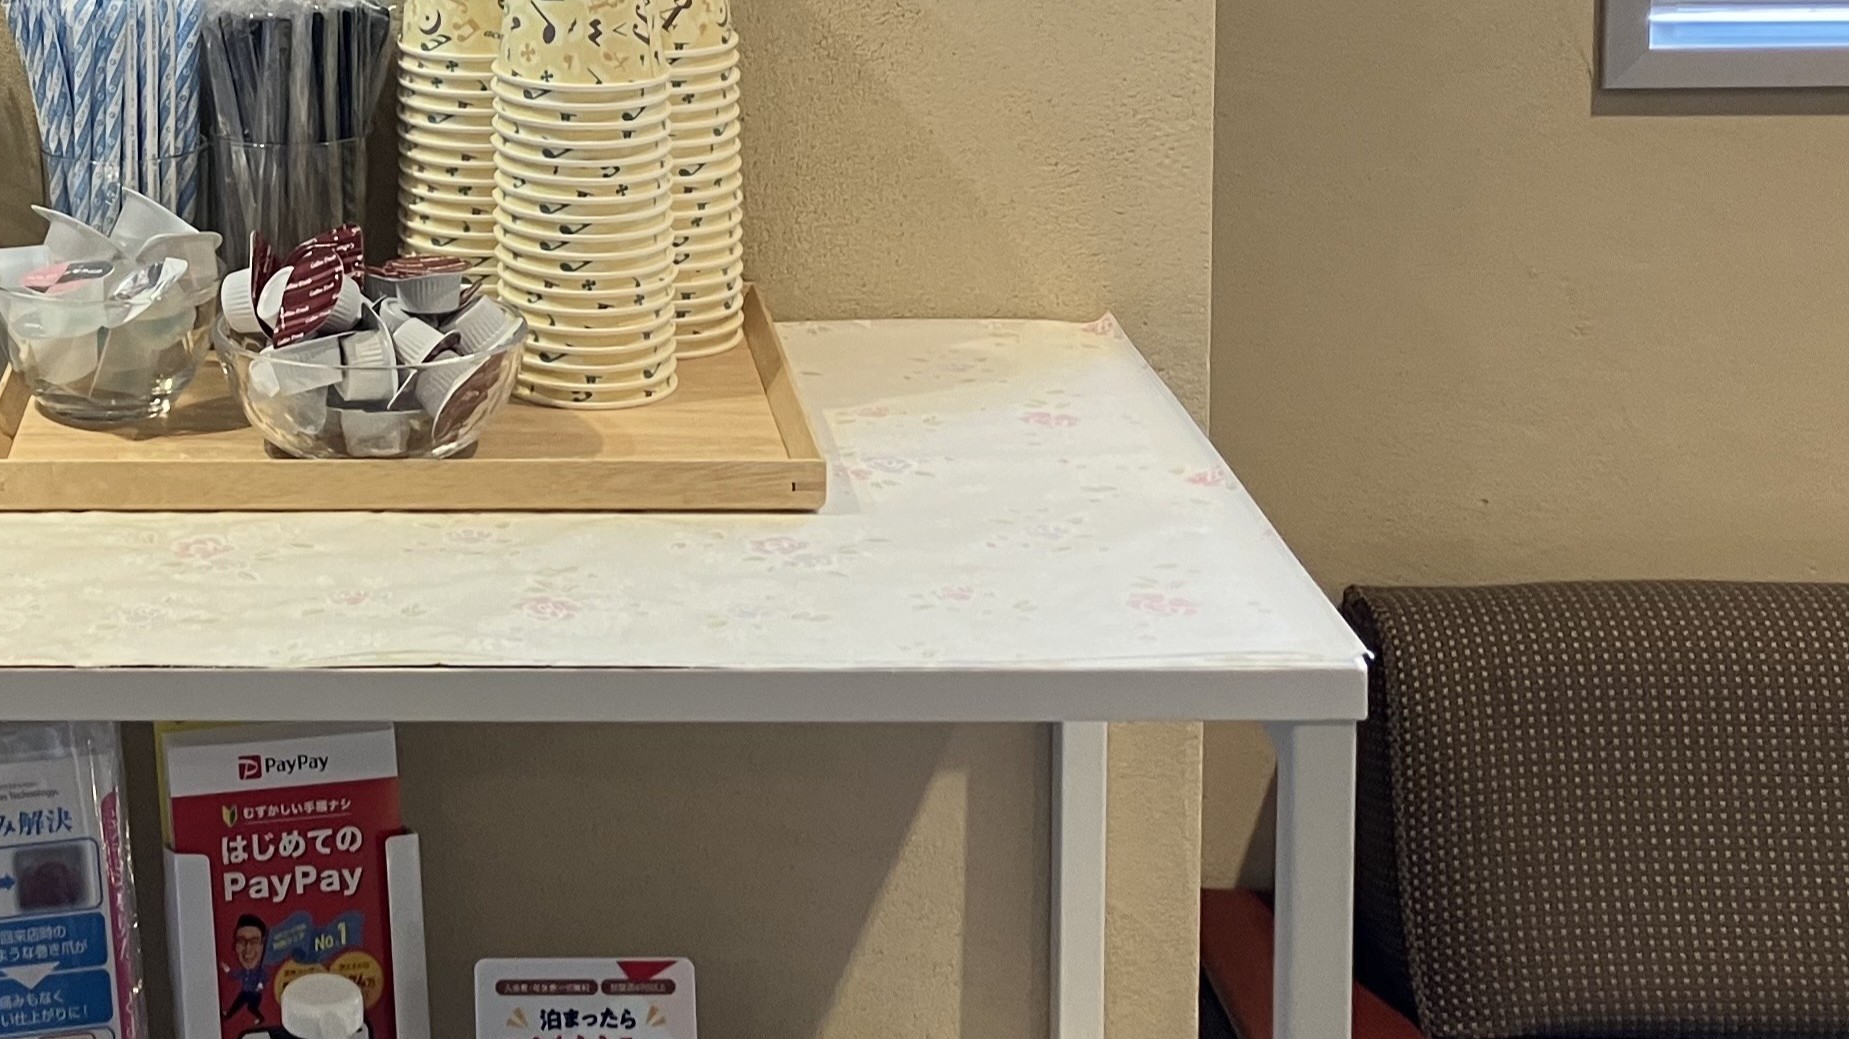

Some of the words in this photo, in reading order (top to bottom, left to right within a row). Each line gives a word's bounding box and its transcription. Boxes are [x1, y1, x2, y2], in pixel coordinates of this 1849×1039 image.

[265, 754, 329, 775] PayPay
[221, 825, 362, 866] はじめての
[223, 864, 363, 903] PayPay
[539, 1008, 637, 1031] 泊まったら
